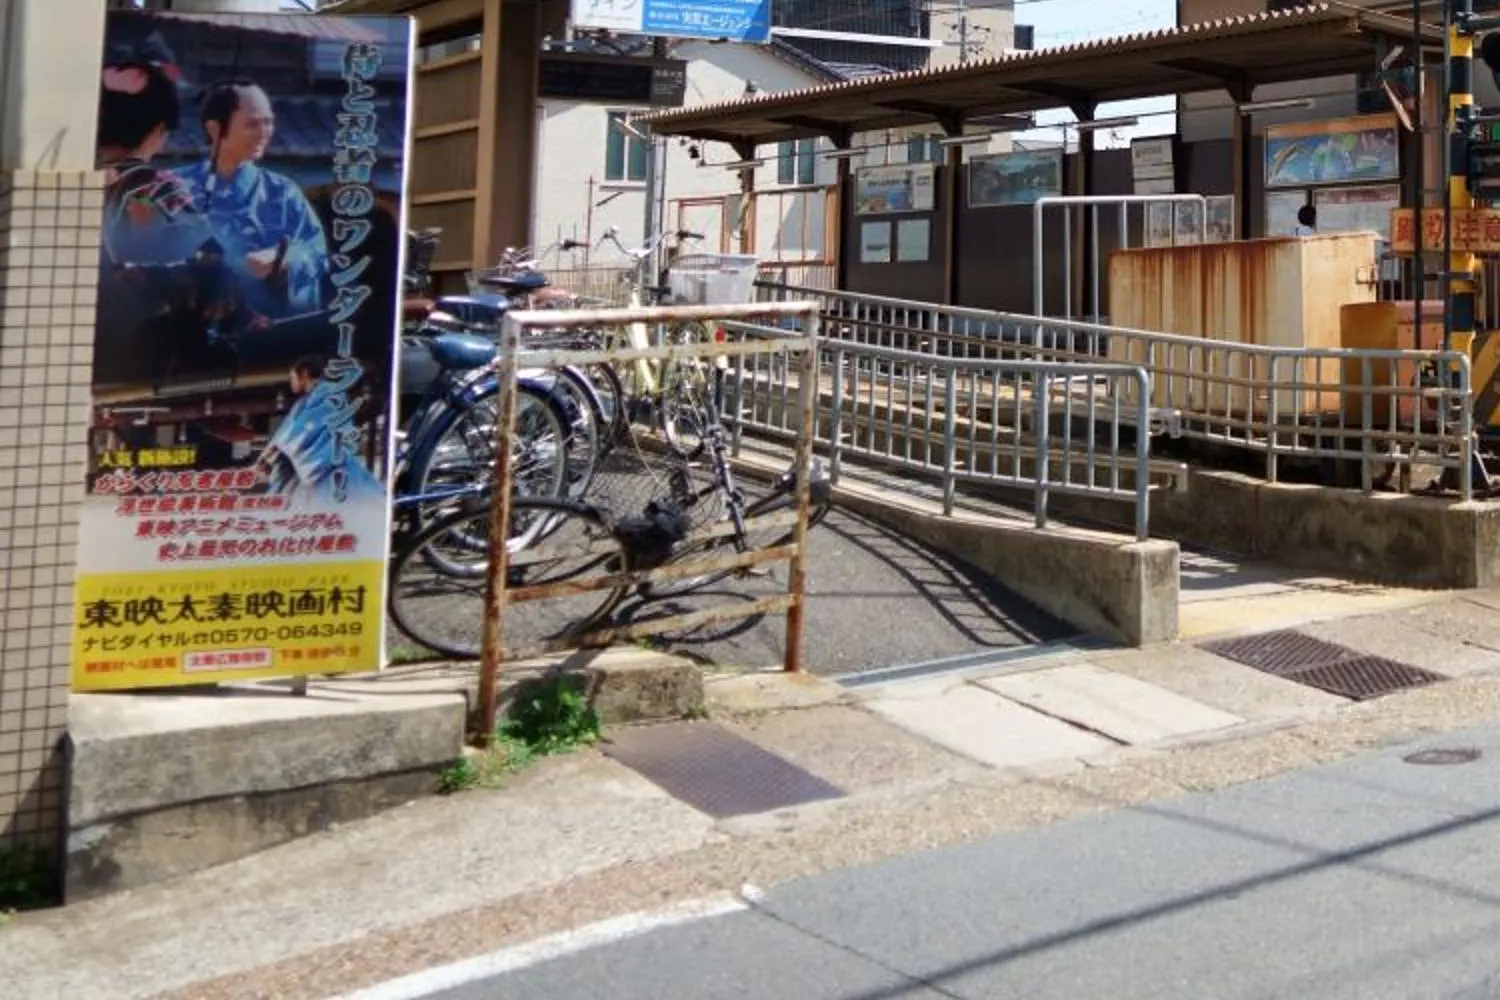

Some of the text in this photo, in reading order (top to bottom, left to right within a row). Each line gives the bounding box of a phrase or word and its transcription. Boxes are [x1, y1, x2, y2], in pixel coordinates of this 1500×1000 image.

[79, 584, 367, 630] 東映太秦映画村
[82, 631, 193, 653] ナビダイヤル
